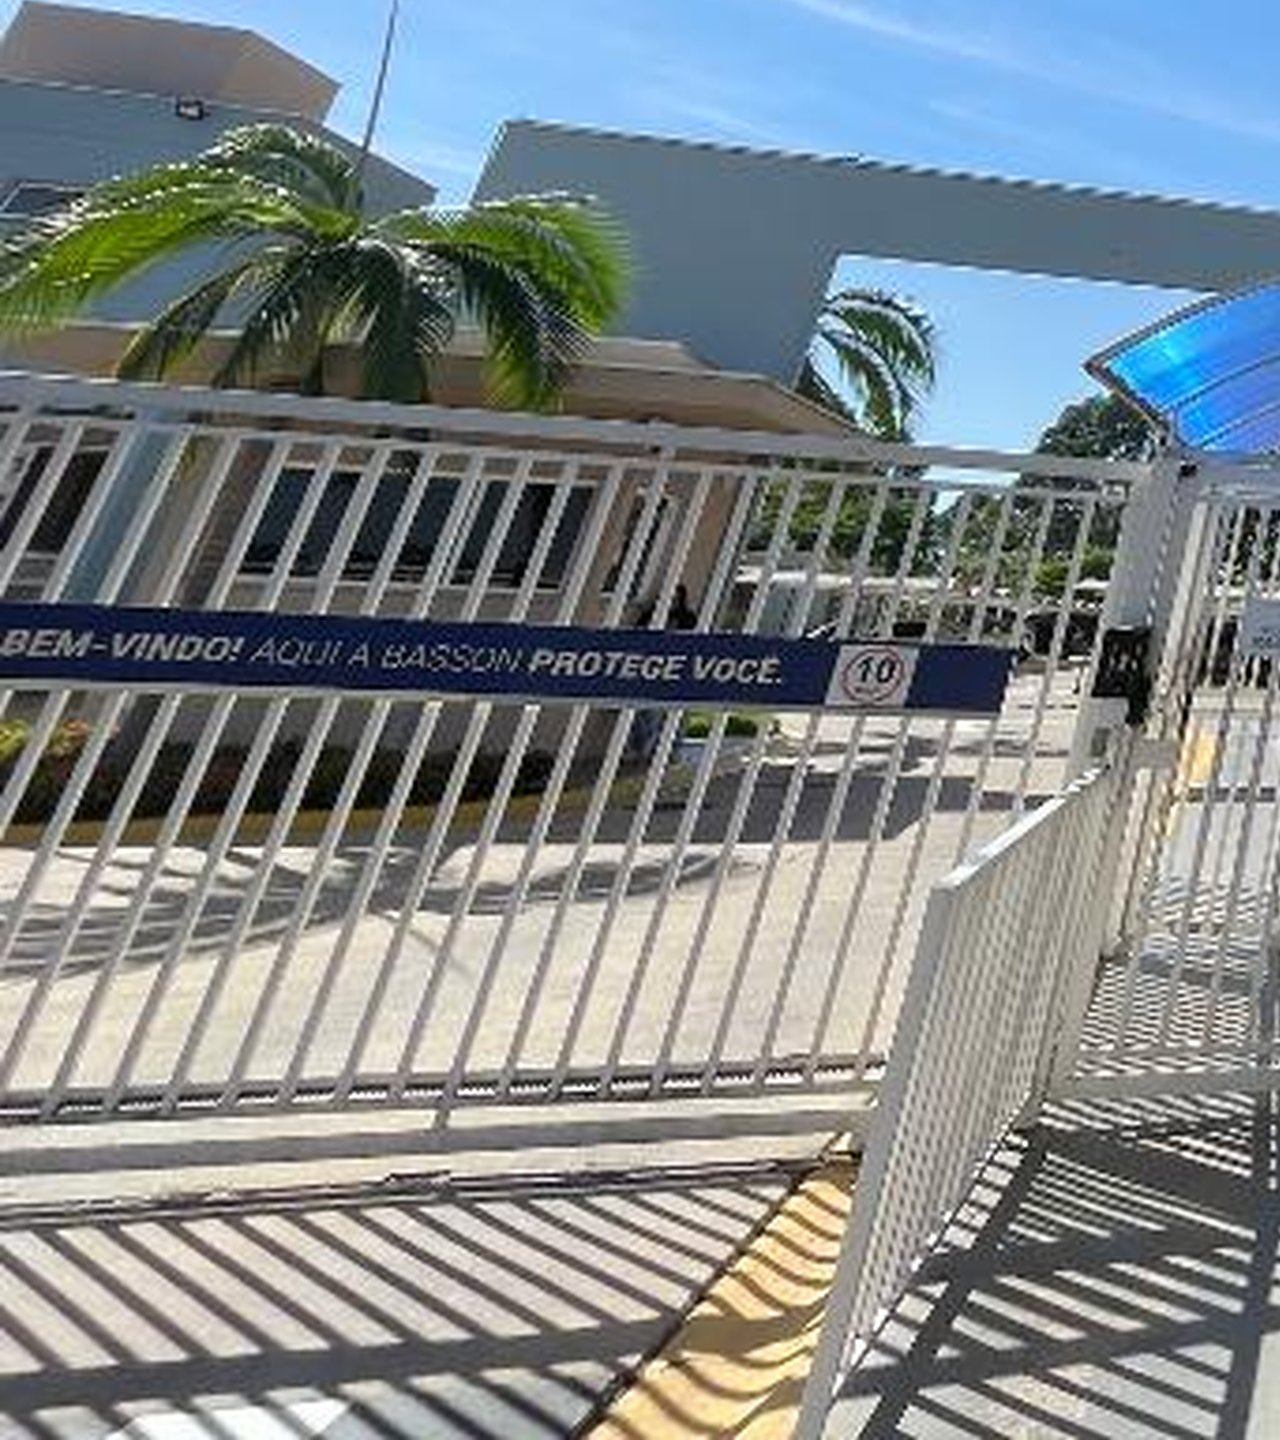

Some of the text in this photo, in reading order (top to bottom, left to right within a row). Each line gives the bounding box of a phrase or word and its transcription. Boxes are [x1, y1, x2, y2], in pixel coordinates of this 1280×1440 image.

[2, 629, 244, 660] BEM-VINDO!
[250, 637, 342, 665] AQUI
[347, 643, 370, 668] A
[381, 645, 520, 673] BASSON
[526, 648, 687, 680] PROTEGE
[858, 656, 896, 683] 10
